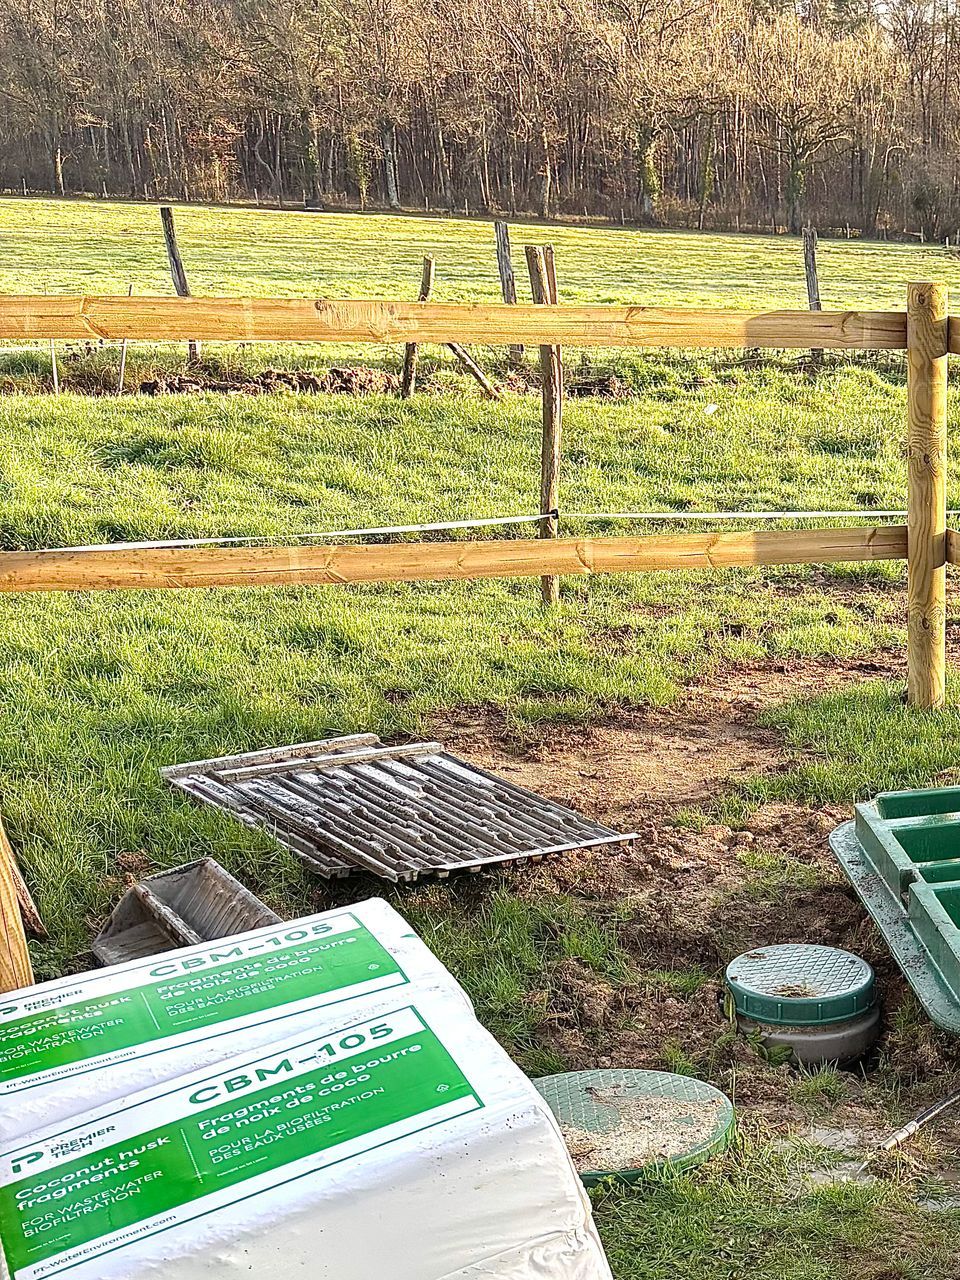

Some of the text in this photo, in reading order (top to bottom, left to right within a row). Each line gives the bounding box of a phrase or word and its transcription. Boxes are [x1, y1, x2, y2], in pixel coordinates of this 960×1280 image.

[150, 923, 333, 977] CBM-105
[156, 962, 263, 994] Fragments
[294, 937, 358, 957] bourre
[24, 990, 83, 1008] PREMIER
[85, 996, 133, 1011] husk
[28, 1018, 125, 1047] WASTEWATER
[189, 1023, 394, 1104] CBM-105
[197, 1044, 423, 1130] Fragments de bourre
[202, 1074, 371, 1140] de noix de coco
[208, 1086, 385, 1156] POUR LA BIOFILTRATION
[50, 1125, 116, 1153] PREMIER
[52, 1141, 93, 1158] TECH
[212, 1149, 243, 1164] DES
[244, 1133, 284, 1152] EAUX
[15, 1136, 172, 1200] Coconut husk
[17, 1159, 140, 1211] fragments
[21, 1170, 163, 1230] FOR WASTEWATER
[23, 1188, 141, 1238] BIOFILTRATION
[33, 1215, 177, 1275] PT-WaterEnvironment.com
